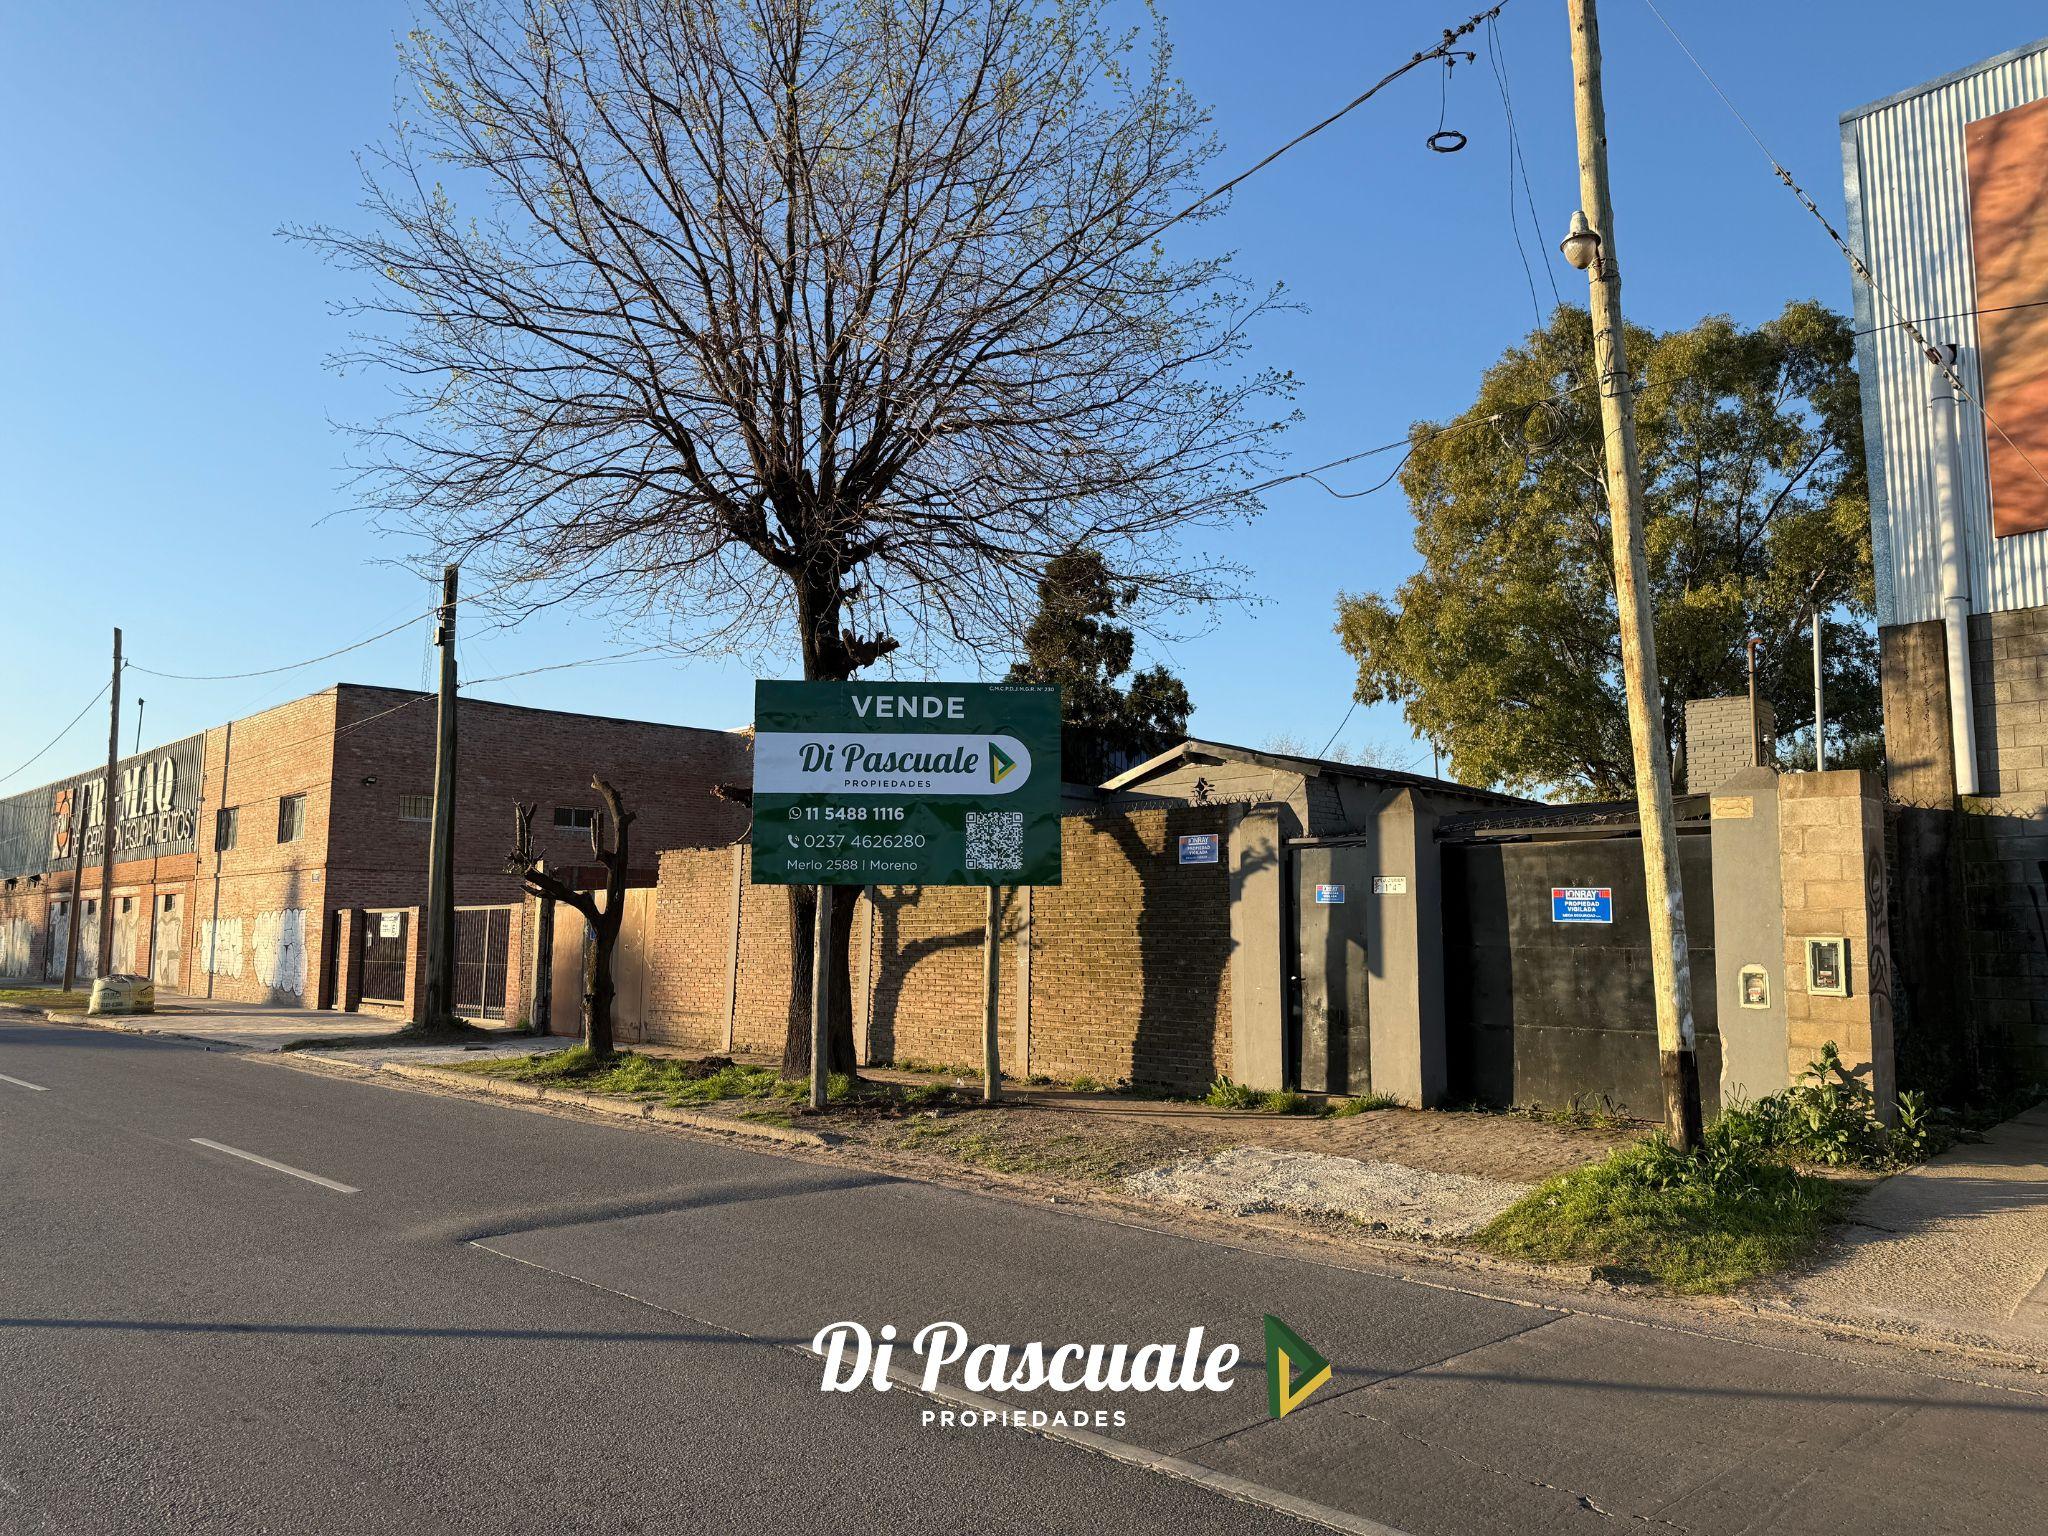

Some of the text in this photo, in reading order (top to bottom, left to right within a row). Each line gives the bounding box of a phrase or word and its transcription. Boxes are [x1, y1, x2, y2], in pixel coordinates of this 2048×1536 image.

[851, 695, 965, 719] VENDE
[799, 743, 979, 774] Di Pascuale
[844, 779, 932, 788] PROPIEDADES
[805, 807, 904, 821] 11 5488 1116
[804, 834, 926, 848] 0237 4626280
[787, 859, 822, 871] Merlo
[826, 859, 858, 871] 2588
[870, 860, 918, 871] Moreno
